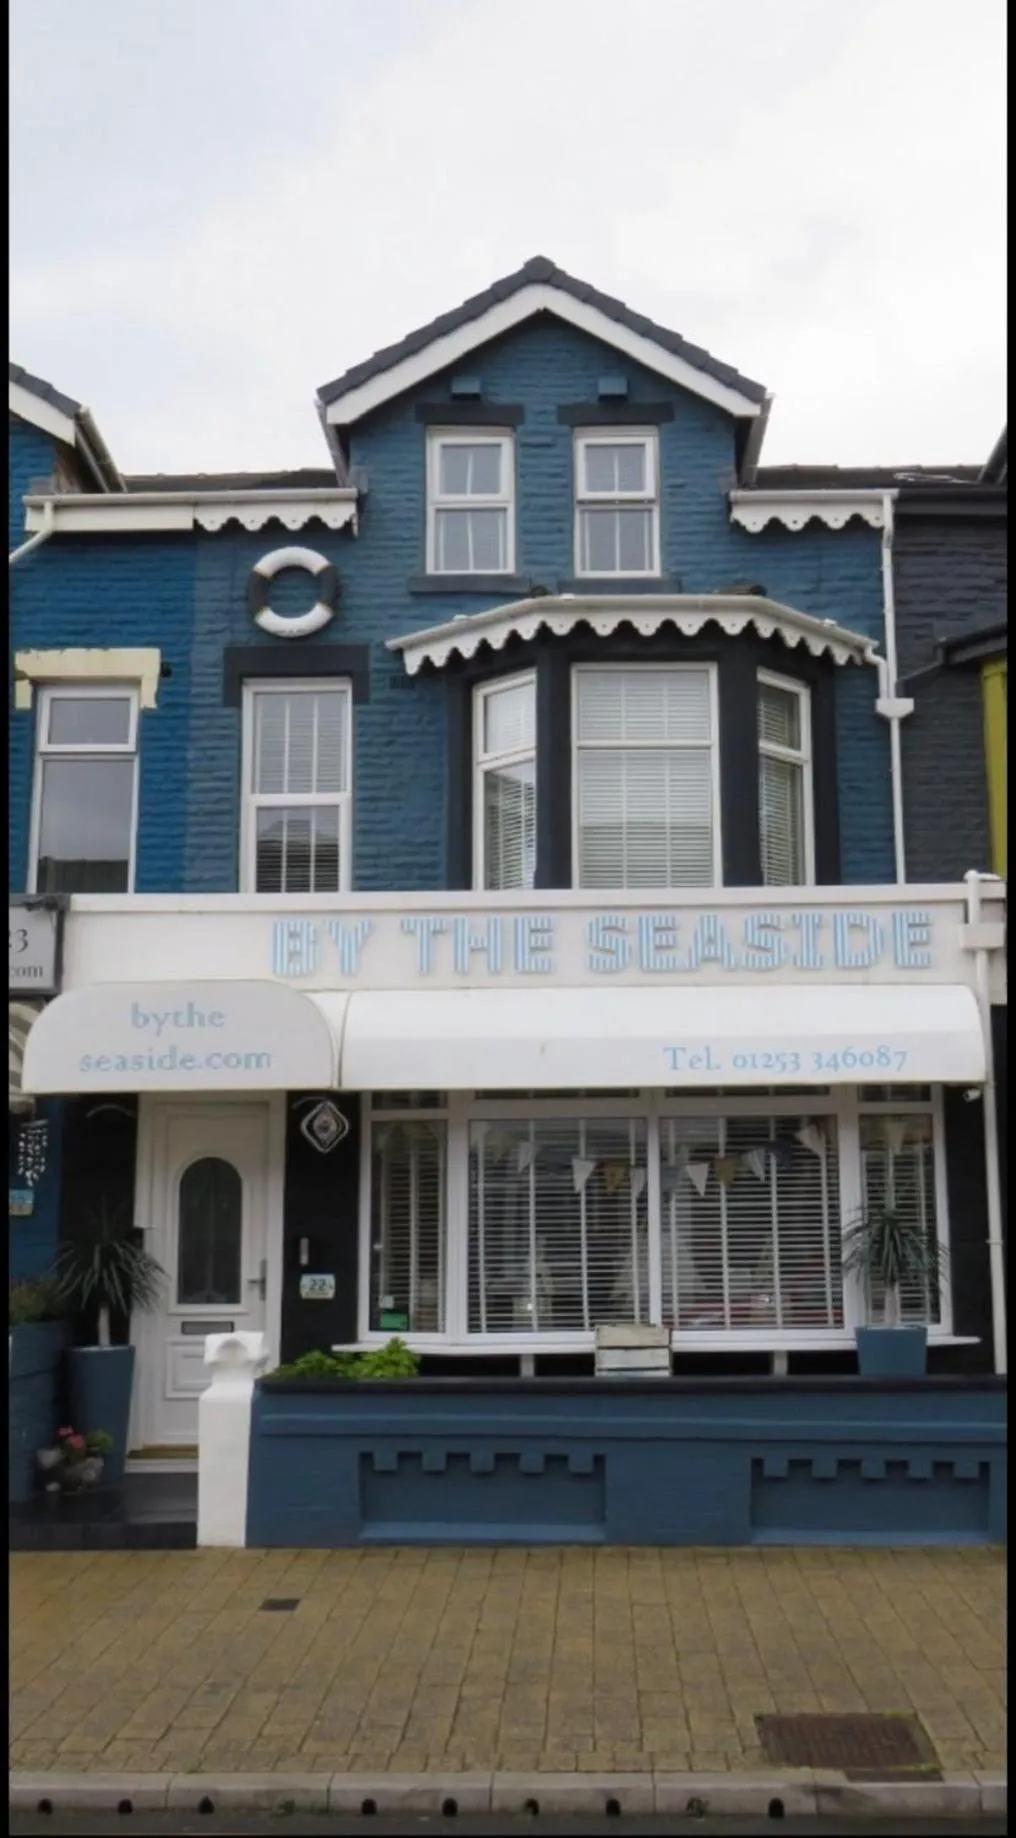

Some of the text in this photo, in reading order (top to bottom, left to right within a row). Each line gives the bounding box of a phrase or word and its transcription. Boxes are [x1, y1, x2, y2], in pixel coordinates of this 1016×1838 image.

[272, 911, 933, 976] BY THE SEASIDE
[131, 1001, 226, 1037] bythe
[79, 1045, 272, 1073] seaside.com
[663, 1045, 907, 1074] Tel. 01253 346087
[309, 1278, 327, 1292] 22
